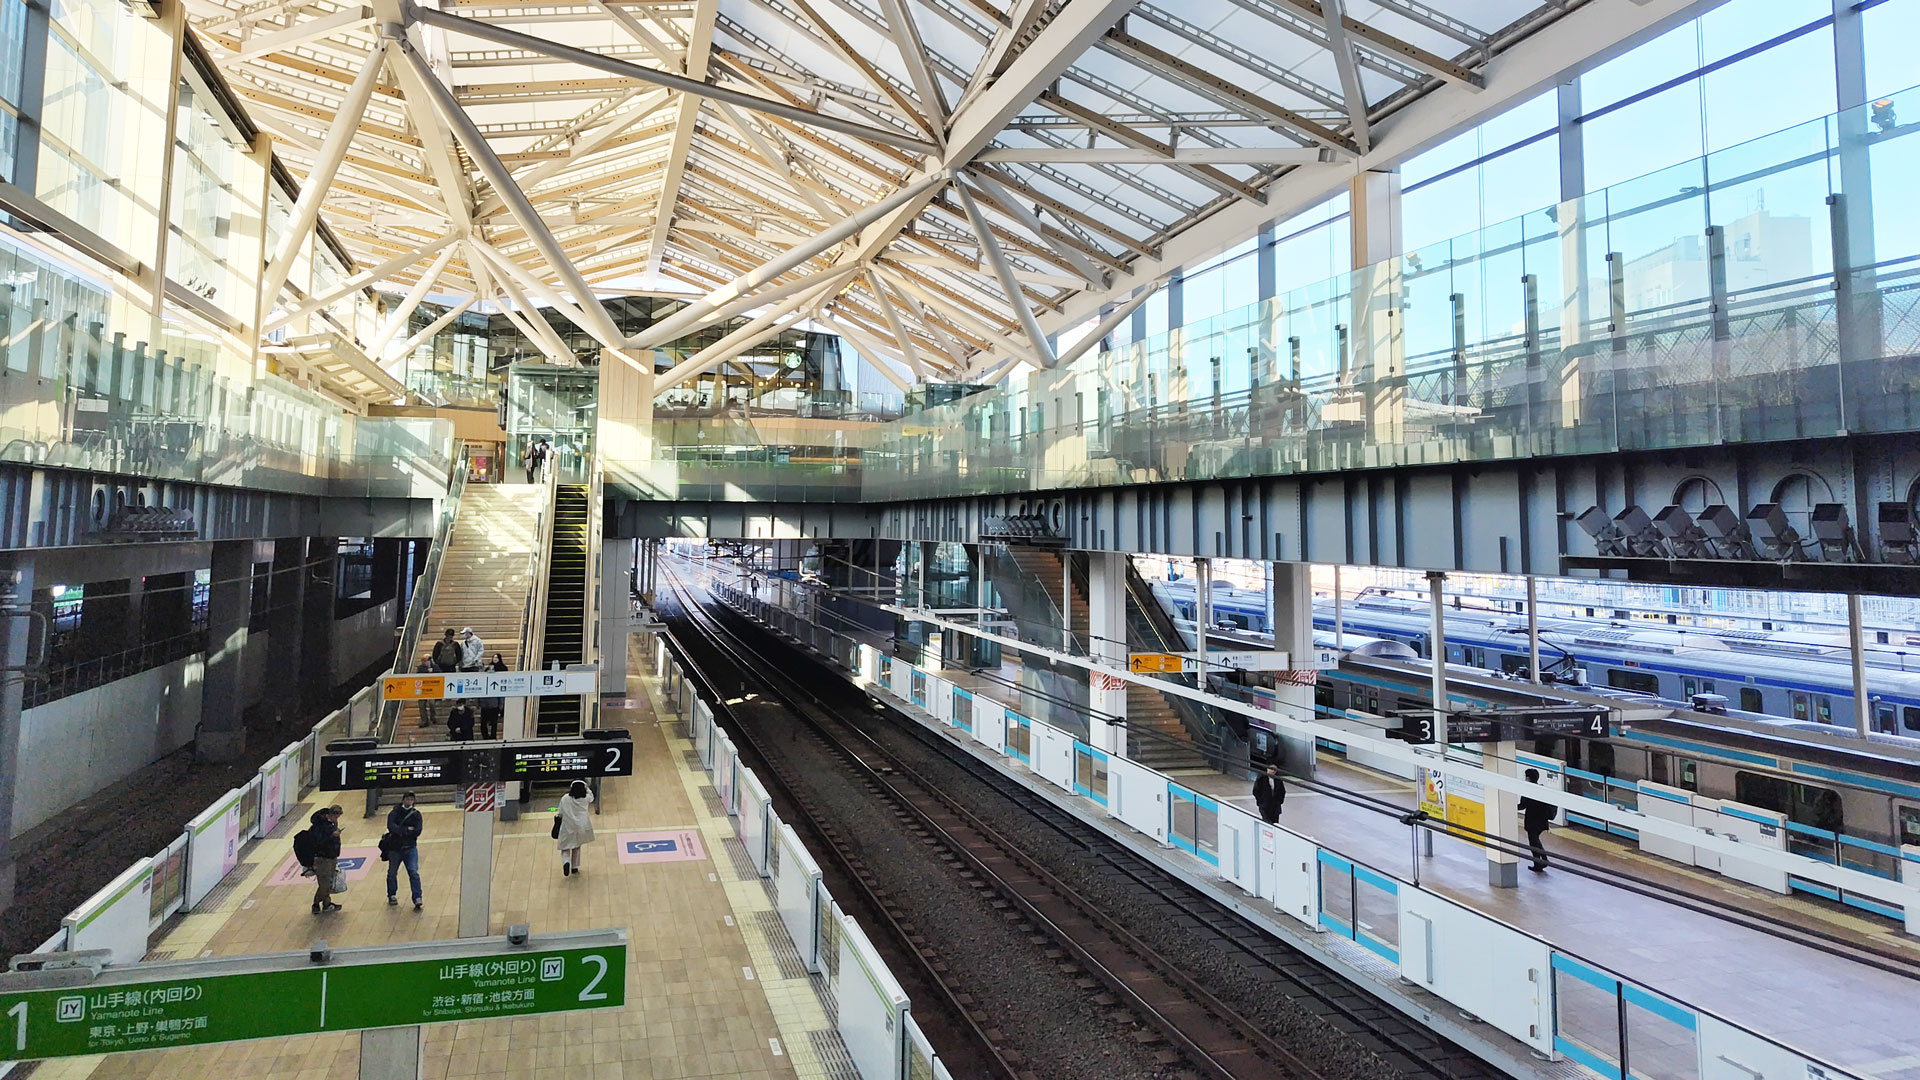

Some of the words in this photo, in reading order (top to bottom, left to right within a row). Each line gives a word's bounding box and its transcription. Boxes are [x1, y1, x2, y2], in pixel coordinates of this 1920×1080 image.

[1419, 720, 1431, 740] 3
[1590, 715, 1603, 734] 4
[604, 747, 621, 772] 2
[336, 760, 347, 786] 1
[473, 978, 515, 988] Yamanote
[517, 975, 536, 984] Line
[545, 963, 559, 975] JY
[578, 954, 608, 1002] 2
[432, 988, 535, 1008] 渋谷・新宿・池袋方面
[62, 1003, 79, 1016] JY
[90, 1009, 140, 1021] Yamanote
[142, 1006, 164, 1016] Line
[423, 1009, 432, 1017] for
[464, 1003, 494, 1014] Shinjuku
[502, 1001, 535, 1010] Ikebukuro
[6, 1001, 28, 1051] 1
[89, 1016, 208, 1039] 東京・上野・巣鴨方面
[88, 1039, 99, 1047] for
[128, 1035, 150, 1045] Ueno
[159, 1032, 191, 1042] Sugamo
